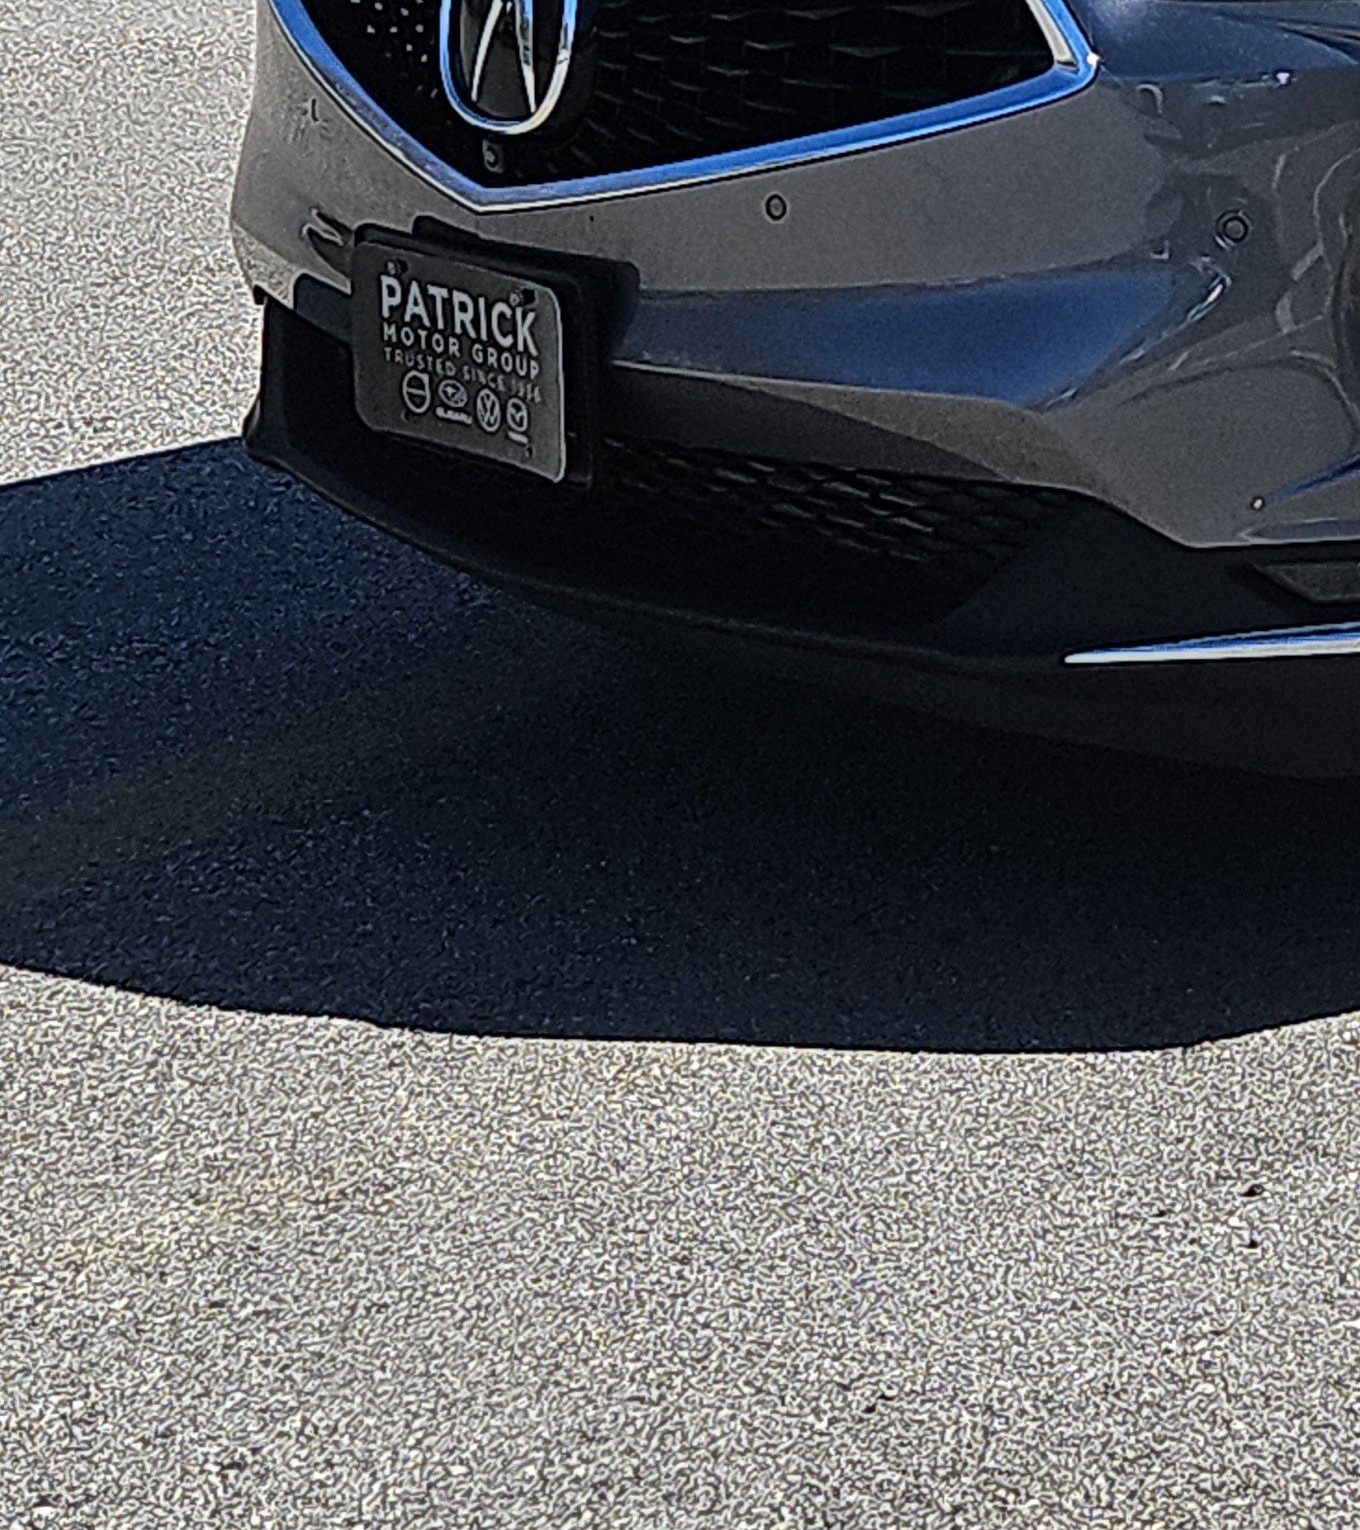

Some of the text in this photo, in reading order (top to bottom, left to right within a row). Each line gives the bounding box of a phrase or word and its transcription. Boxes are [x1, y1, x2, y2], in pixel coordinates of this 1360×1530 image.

[379, 274, 538, 357] PATRICK
[383, 321, 540, 380] MOTOR GROUP
[383, 346, 456, 377] TRUSTED
[462, 365, 506, 392] SINCE
